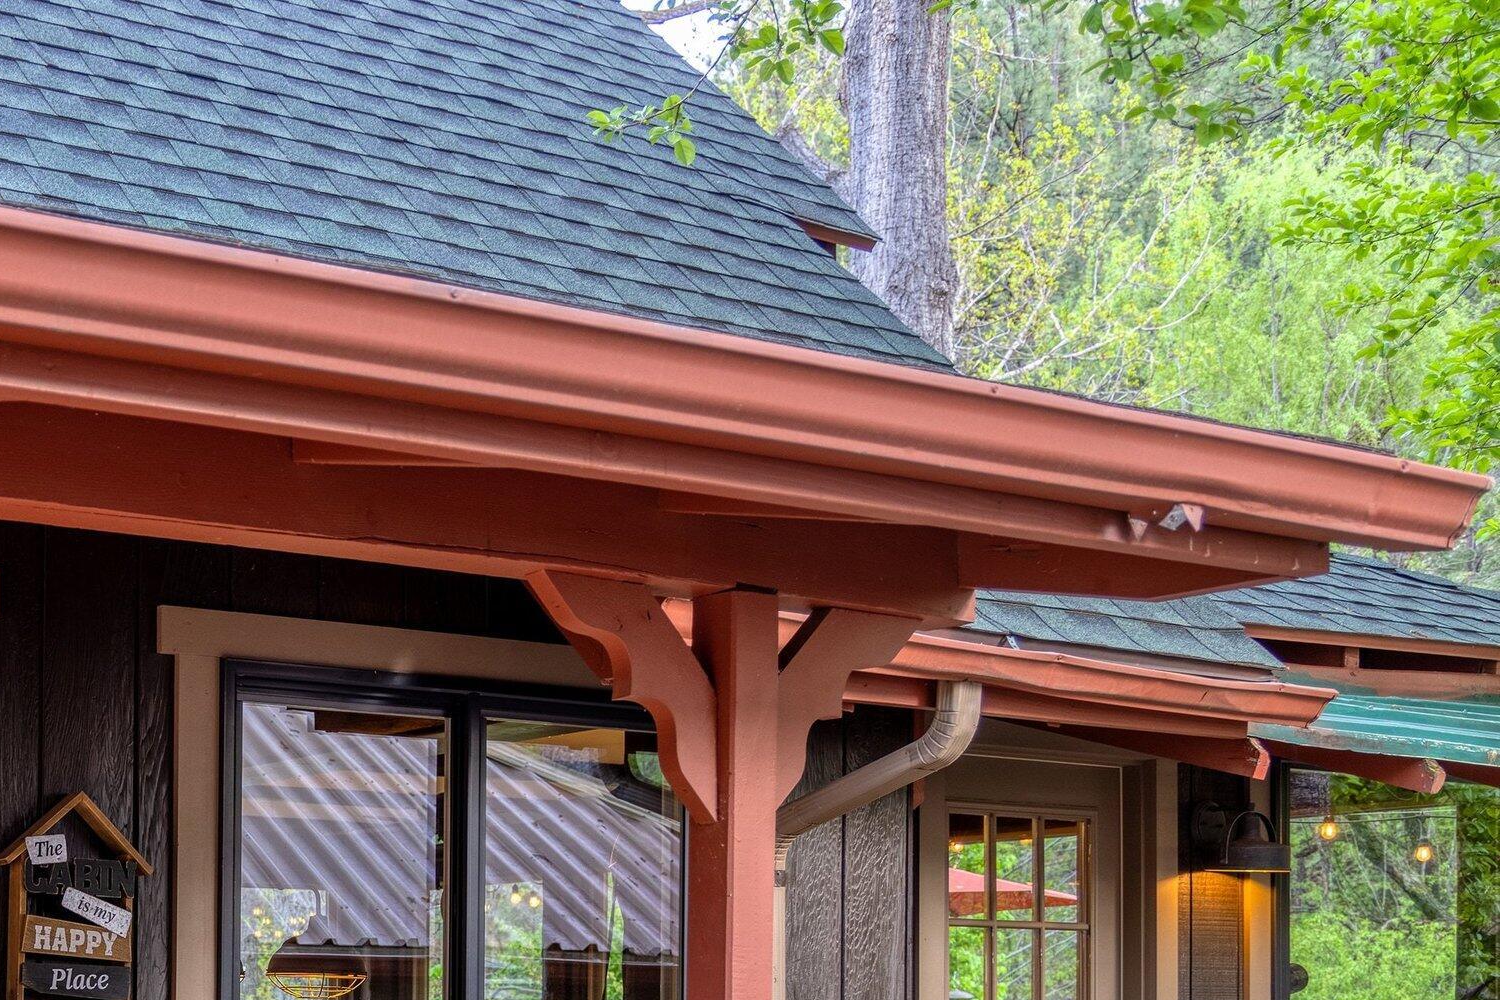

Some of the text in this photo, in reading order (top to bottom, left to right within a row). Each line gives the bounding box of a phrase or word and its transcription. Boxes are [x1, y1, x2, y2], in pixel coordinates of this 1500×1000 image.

[34, 841, 63, 857] The
[24, 858, 137, 898] CABIN
[77, 896, 116, 924] is my
[33, 924, 118, 956] HAPPY
[49, 968, 110, 990] Place
